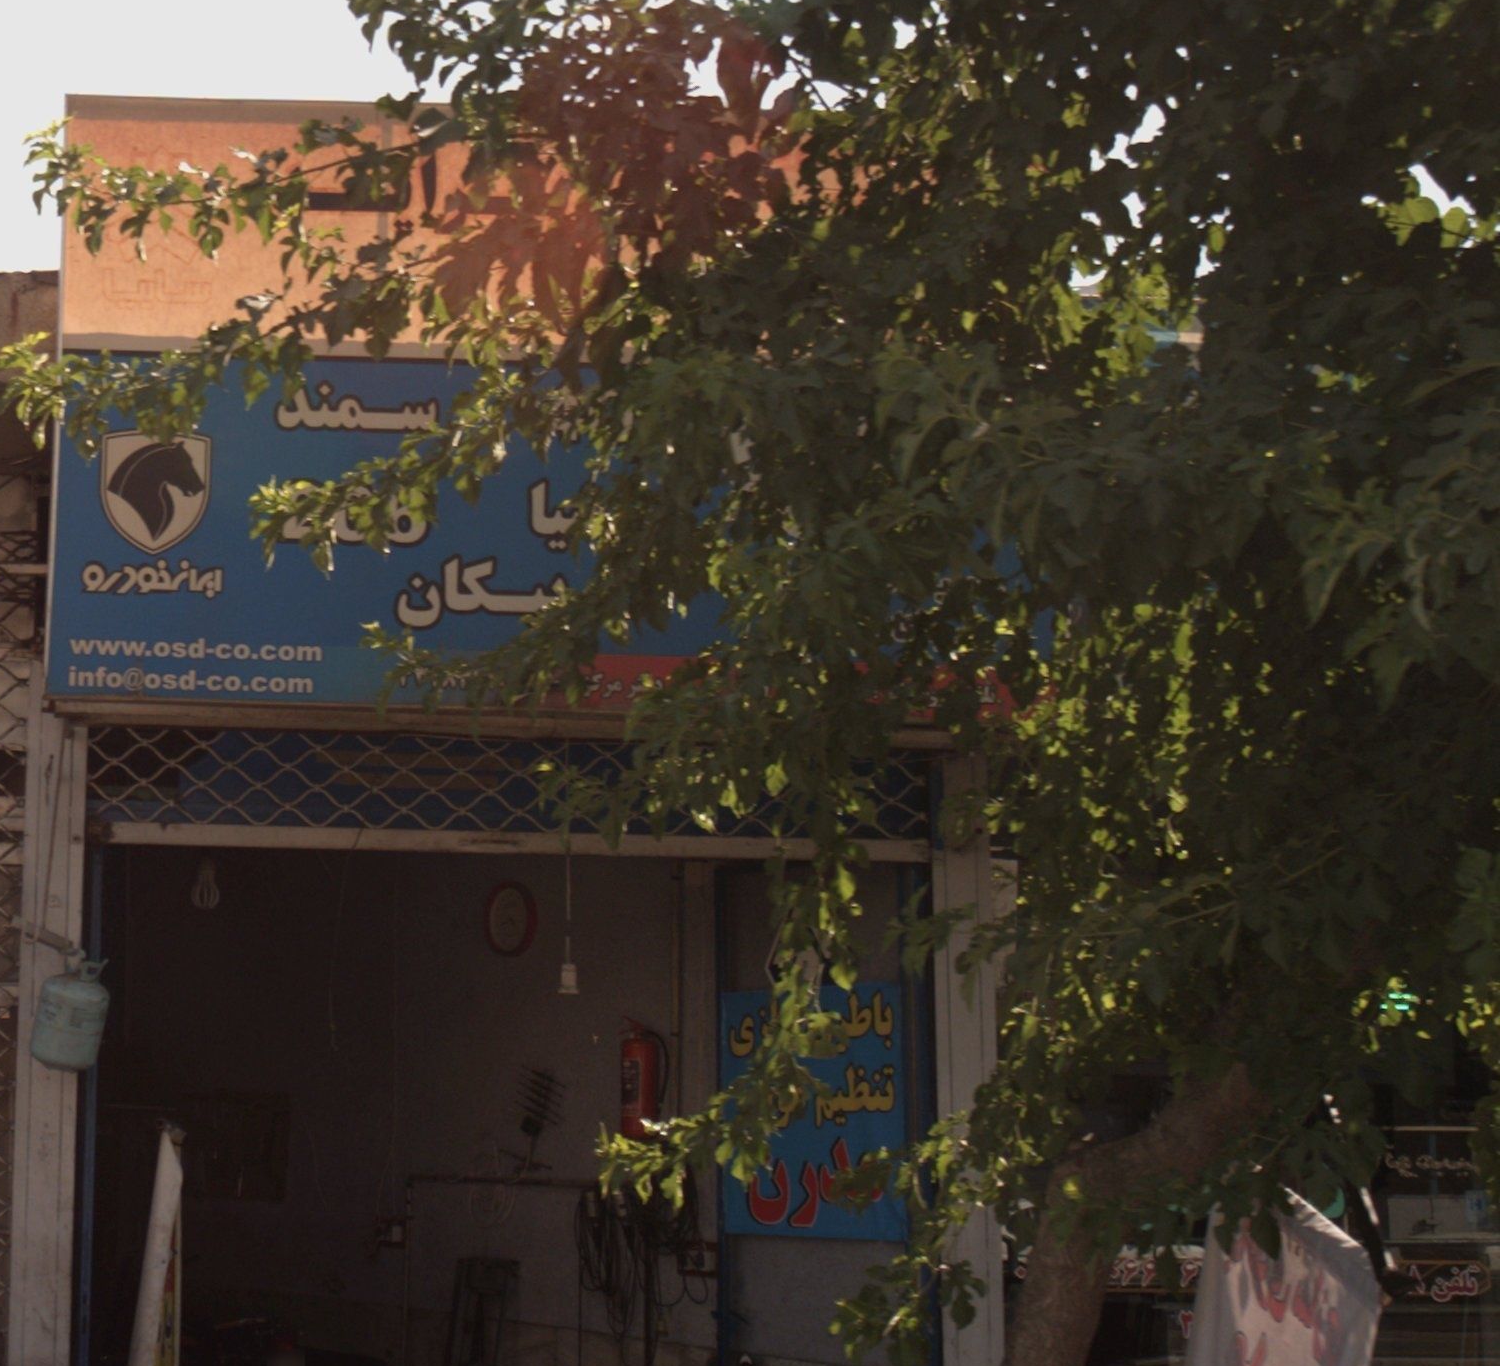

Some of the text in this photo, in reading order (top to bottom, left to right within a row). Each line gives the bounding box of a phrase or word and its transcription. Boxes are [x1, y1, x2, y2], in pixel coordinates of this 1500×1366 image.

[273, 380, 440, 432] سمند
[69, 637, 324, 663] www.osd-co.com
[67, 666, 314, 694] info@osd-co.com
[1430, 1262, 1481, 1304] تلفن
